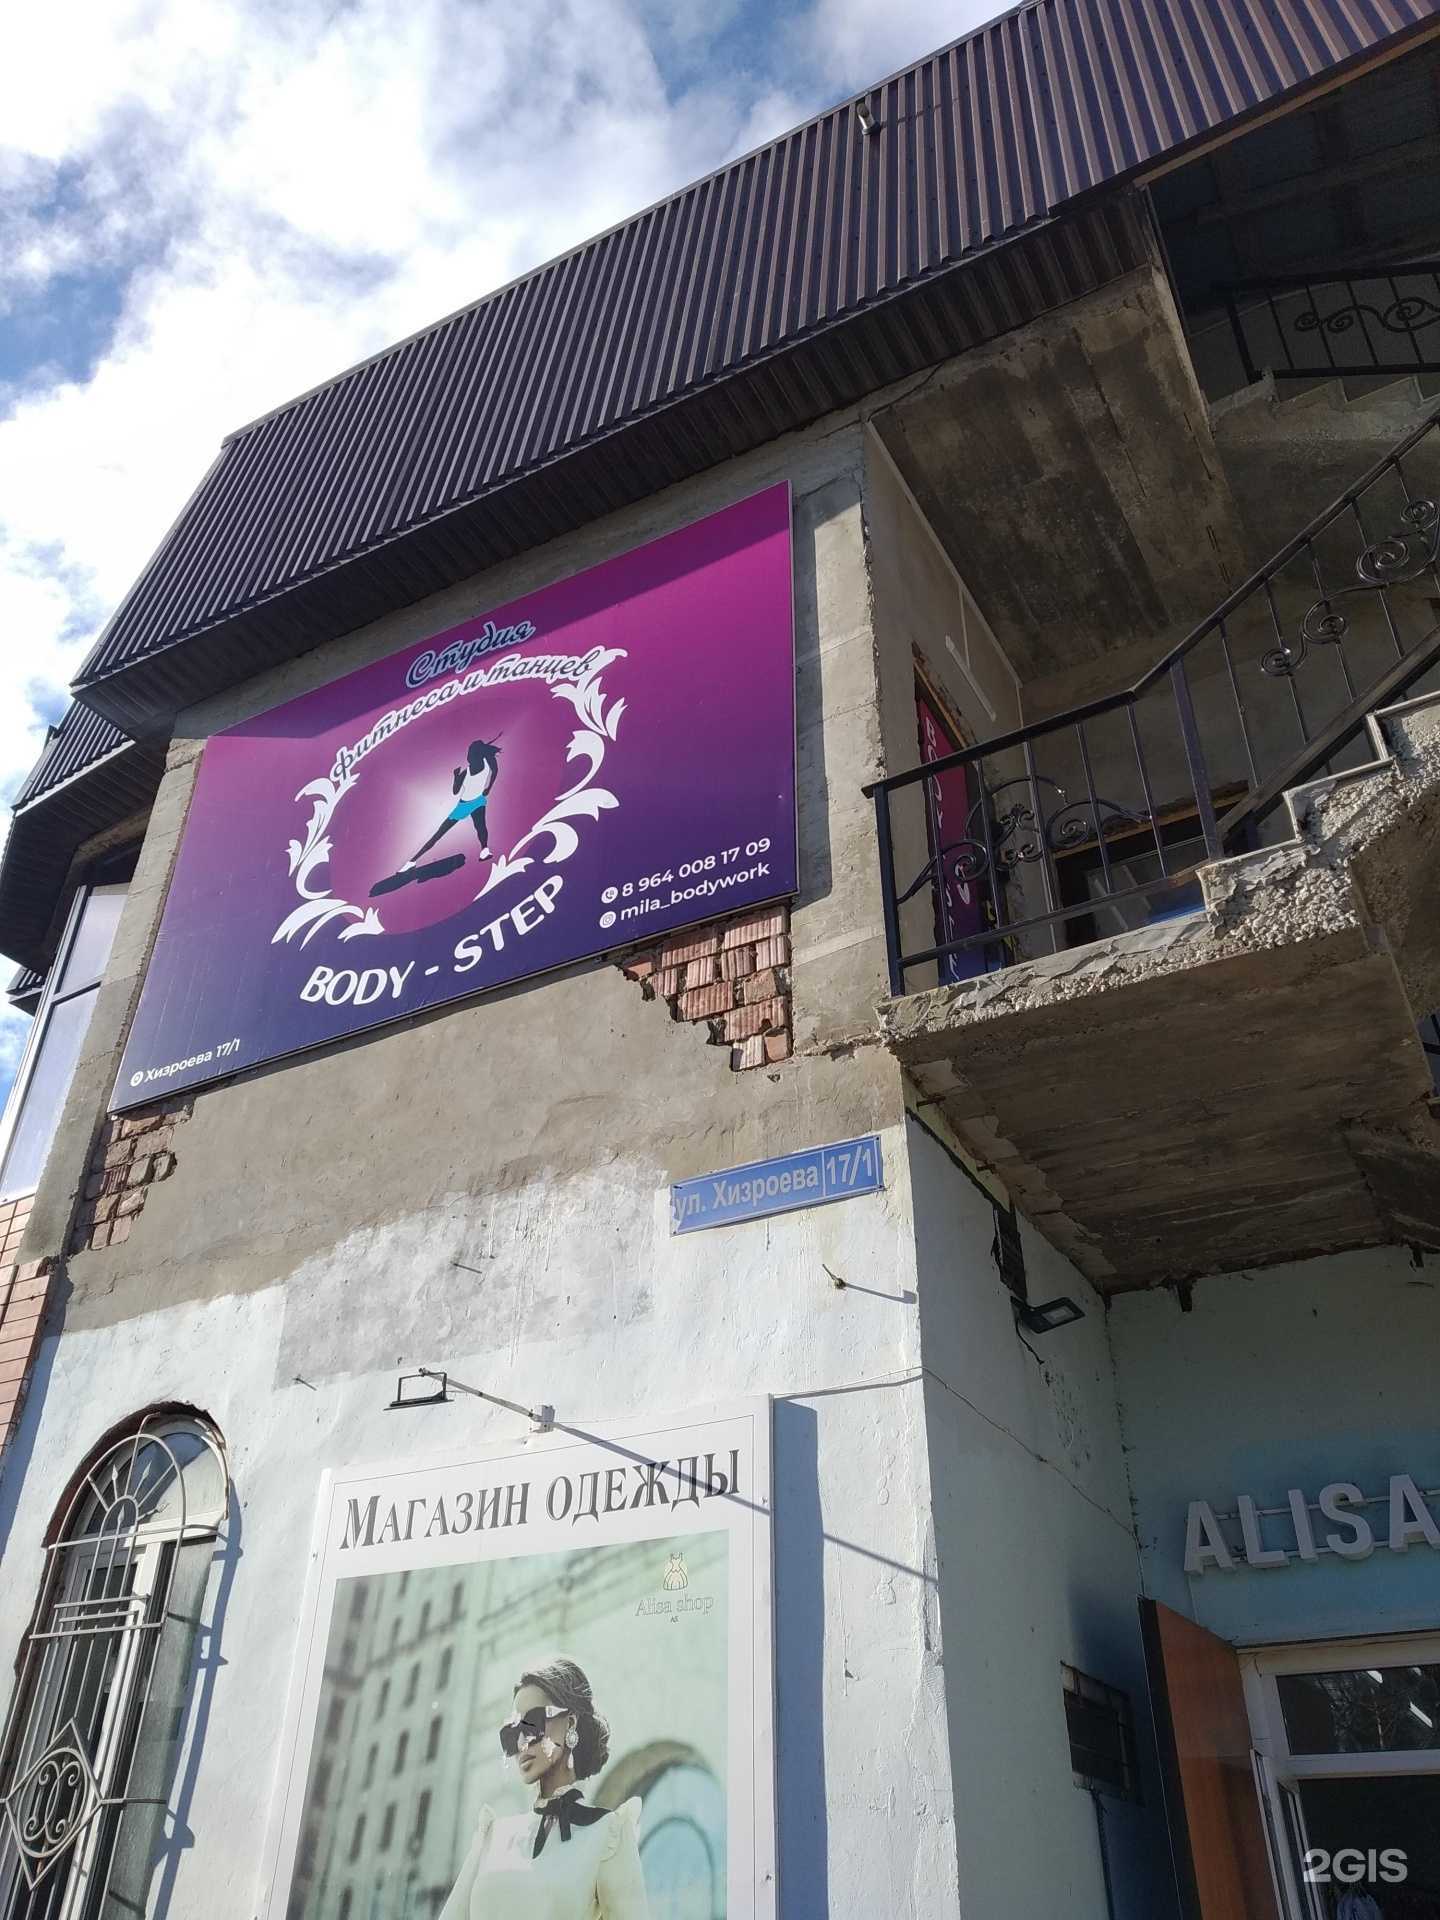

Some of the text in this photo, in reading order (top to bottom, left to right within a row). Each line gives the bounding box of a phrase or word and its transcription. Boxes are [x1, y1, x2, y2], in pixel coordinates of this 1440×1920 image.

[406, 622, 535, 687] Студия
[331, 648, 601, 781] фитнеса и танцев
[620, 861, 771, 921] mila_bodywork
[621, 837, 771, 897] 8 964 008 17 09
[300, 960, 415, 1006] BODY
[454, 874, 564, 973] STEP
[144, 1037, 241, 1083] Хизроева 17/1
[674, 1144, 873, 1223] ул. Хизроева 17/1
[1183, 1473, 1440, 1575] ALISA
[634, 1591, 714, 1617] Alisa shop
